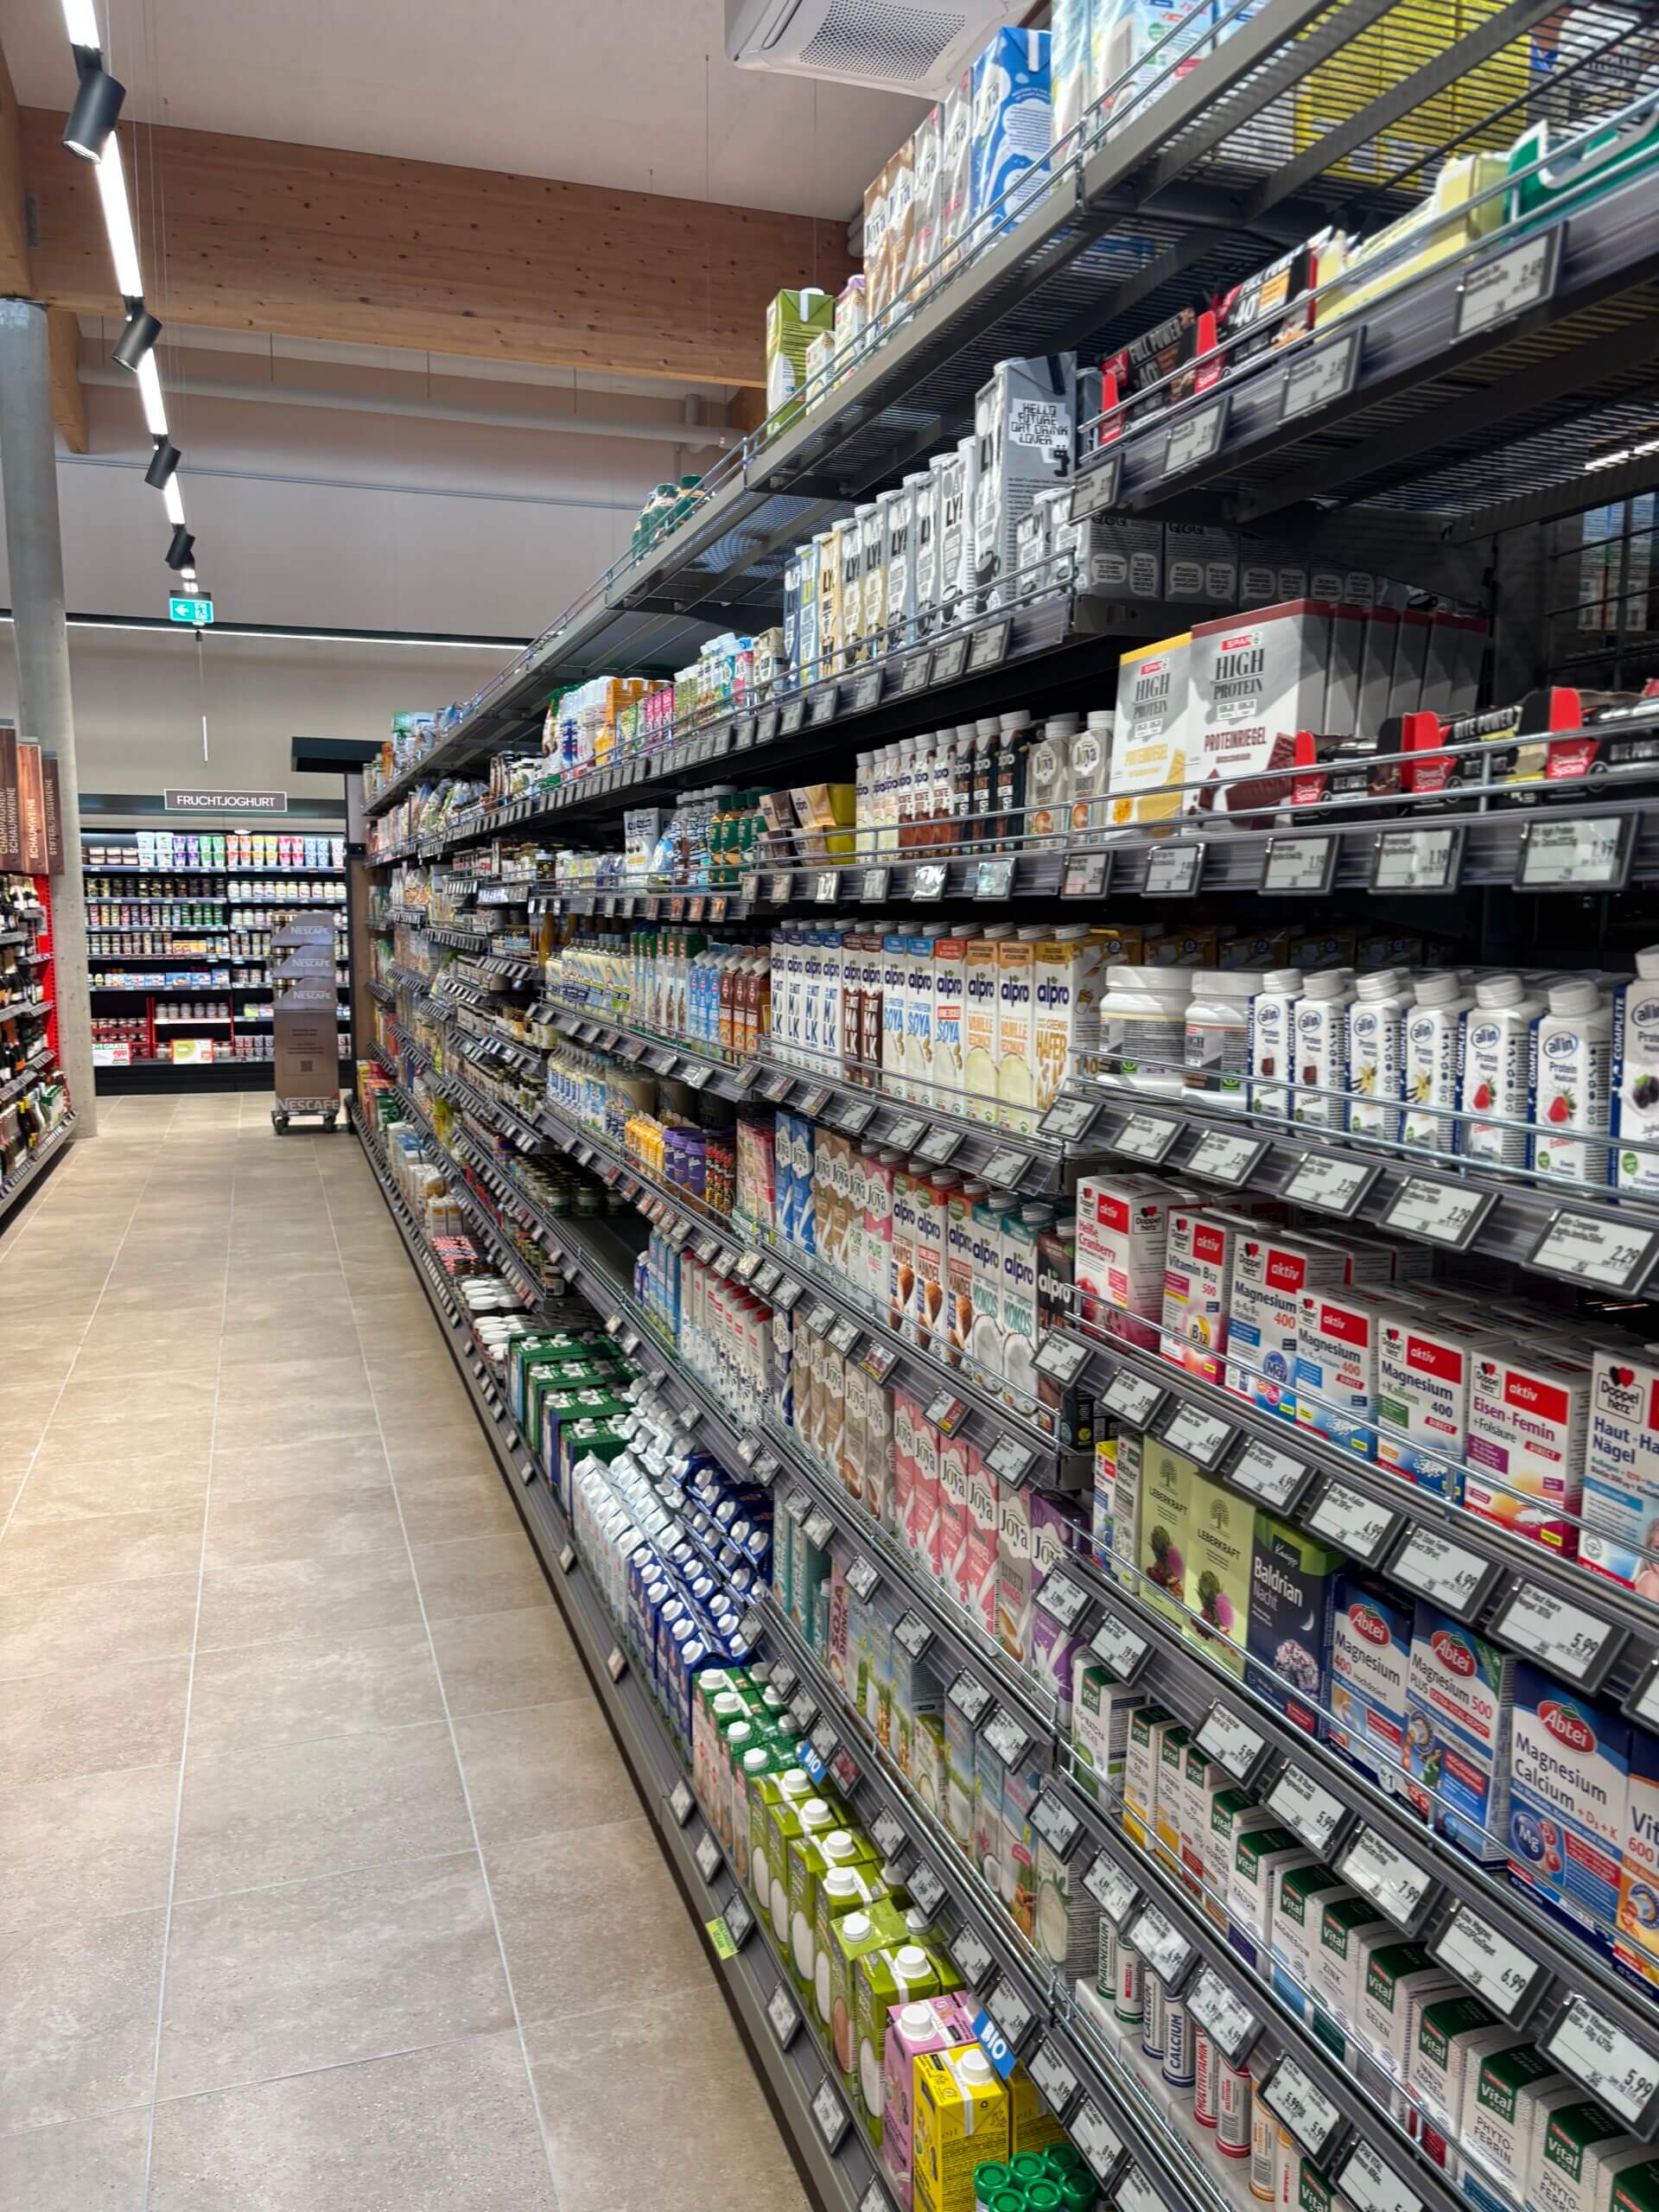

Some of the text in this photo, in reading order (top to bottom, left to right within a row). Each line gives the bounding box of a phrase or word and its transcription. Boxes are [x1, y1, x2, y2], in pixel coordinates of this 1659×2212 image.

[1017, 412, 1058, 425] FUTURE
[1022, 402, 1058, 416] HELLO
[1019, 433, 1053, 445] LOVER
[1033, 423, 1069, 436] DRINK
[1215, 648, 1265, 681] HIGH
[1135, 673, 1170, 702] HIGH
[1213, 677, 1263, 700] PROTEIN
[1133, 699, 1167, 720] PROTEIN
[1477, 708, 1515, 735] POWER
[176, 795, 276, 807] FRUCHTJOGHURT
[7, 787, 18, 854] SCHAUMWEINE
[27, 798, 40, 859] SCHAUMWEINE
[884, 964, 905, 990] alpro
[908, 967, 931, 995] alpro
[937, 969, 962, 999] alpro
[968, 972, 994, 1002] alpro
[1001, 976, 1029, 1007] alpro
[1036, 976, 1070, 1009] alpro
[884, 1006, 904, 1032] SOYA
[907, 1010, 931, 1037] SOYA
[937, 1020, 959, 1043] SOYA
[1614, 997, 1625, 1061] COMPLETE
[1456, 1021, 1466, 1077] COMPLETE
[1529, 1029, 1538, 1088] COMPLETE
[1548, 1038, 1573, 1053] allin
[1548, 1061, 1578, 1075] Protein
[868, 1183, 887, 1213] Joya
[1099, 1204, 1118, 1219] aktiv
[893, 1200, 915, 1224] alpro
[1135, 1216, 1162, 1226] Doppel
[1447, 1205, 1470, 1224] 2.29
[918, 1213, 941, 1240] alpro
[973, 1236, 1000, 1268] alpro
[1078, 1235, 1116, 1262] Cranberry
[1196, 1236, 1220, 1251] aktiv
[1610, 1244, 1641, 1264] 2.29
[1004, 1252, 1034, 1285] alpro
[1168, 1255, 1217, 1283] Vitamin B12
[1271, 1262, 1300, 1281] aktiv
[1039, 1268, 1071, 1303] alpro
[1201, 1283, 1217, 1297] 500
[1235, 1281, 1297, 1313] Magnesium
[1192, 1324, 1208, 1344] B12
[1274, 1313, 1296, 1330] 400
[1323, 1313, 1346, 1330] aktiv
[1299, 1328, 1361, 1364] Magnesium
[1409, 1346, 1435, 1364] aktiv
[1341, 1362, 1361, 1377] 400
[1382, 1359, 1453, 1402] Magnesium
[1510, 1382, 1538, 1402] aktiv
[1600, 1380, 1639, 1405] Doppel
[1606, 1395, 1631, 1415] herz
[1431, 1401, 1453, 1419] 400
[1427, 1417, 1454, 1434] DIRECT
[1472, 1416, 1517, 1444] +Folsäure
[915, 1436, 935, 1472] Joya
[1527, 1442, 1559, 1461] DIRECT
[1592, 1433, 1636, 1465] Nägel
[942, 1458, 965, 1499] Joya
[969, 1481, 994, 1522] Joya
[1148, 1487, 1188, 1516] LEBERKRAFT
[1001, 1508, 1028, 1550] Joya
[1363, 1520, 1383, 1537] 4.99
[1197, 1527, 1241, 1560] LEBERKRAFT
[1254, 1556, 1303, 1608] Baldrian
[1453, 1569, 1478, 1591] 4.99
[1254, 1580, 1278, 1611] Nacht
[831, 1586, 844, 1650] SOJA
[1351, 1611, 1387, 1642] Abtei
[838, 1608, 849, 1657] DRINK
[1570, 1632, 1599, 1655] 5.99
[1334, 1654, 1352, 1675] 400
[1335, 1630, 1402, 1687] Magnesium
[1433, 1638, 1471, 1672] Abtei
[1410, 1673, 1429, 1694] PLUS
[1412, 1653, 1493, 1720] Magnesium 500
[1541, 1707, 1592, 1745] Abtei
[804, 1748, 822, 1772] BIO
[1237, 1744, 1255, 1762] 5.99
[1516, 1732, 1608, 1806] Magnesium
[1515, 1758, 1575, 1813] Calcium
[1212, 1813, 1231, 1831] Vital
[1316, 1810, 1336, 1832] 5.99
[1519, 1823, 1540, 1853] Mg
[1627, 1837, 1655, 1864] 600
[1236, 1855, 1256, 1876] Vital
[1398, 1879, 1421, 1904] 7.99
[1281, 1894, 1303, 1917] Vital
[1323, 1926, 1346, 1949] Vital
[1099, 1921, 1109, 1987] MAGNESIUM
[1323, 1961, 1341, 1982] ZINK
[1500, 1967, 1527, 1993] 6.99
[1369, 1974, 1393, 2000] Vital
[1365, 2007, 1390, 2039] SELEN
[980, 2022, 1007, 2060] BIO
[1170, 2012, 1183, 2069] CALCIUM
[1421, 2031, 1446, 2058] Vital
[1195, 2040, 1208, 2113] MULTIVITAMIN
[1624, 2068, 1653, 2099] 5.99
[1480, 2082, 1512, 2112] Vital
[1310, 2121, 1327, 2142] 5.99
[1473, 2126, 1511, 2164] FERRIN
[1476, 2115, 1515, 2151] PHYTO-
[1548, 2137, 1580, 2170] Vital
[1543, 2171, 1581, 2211] PHYTO-
